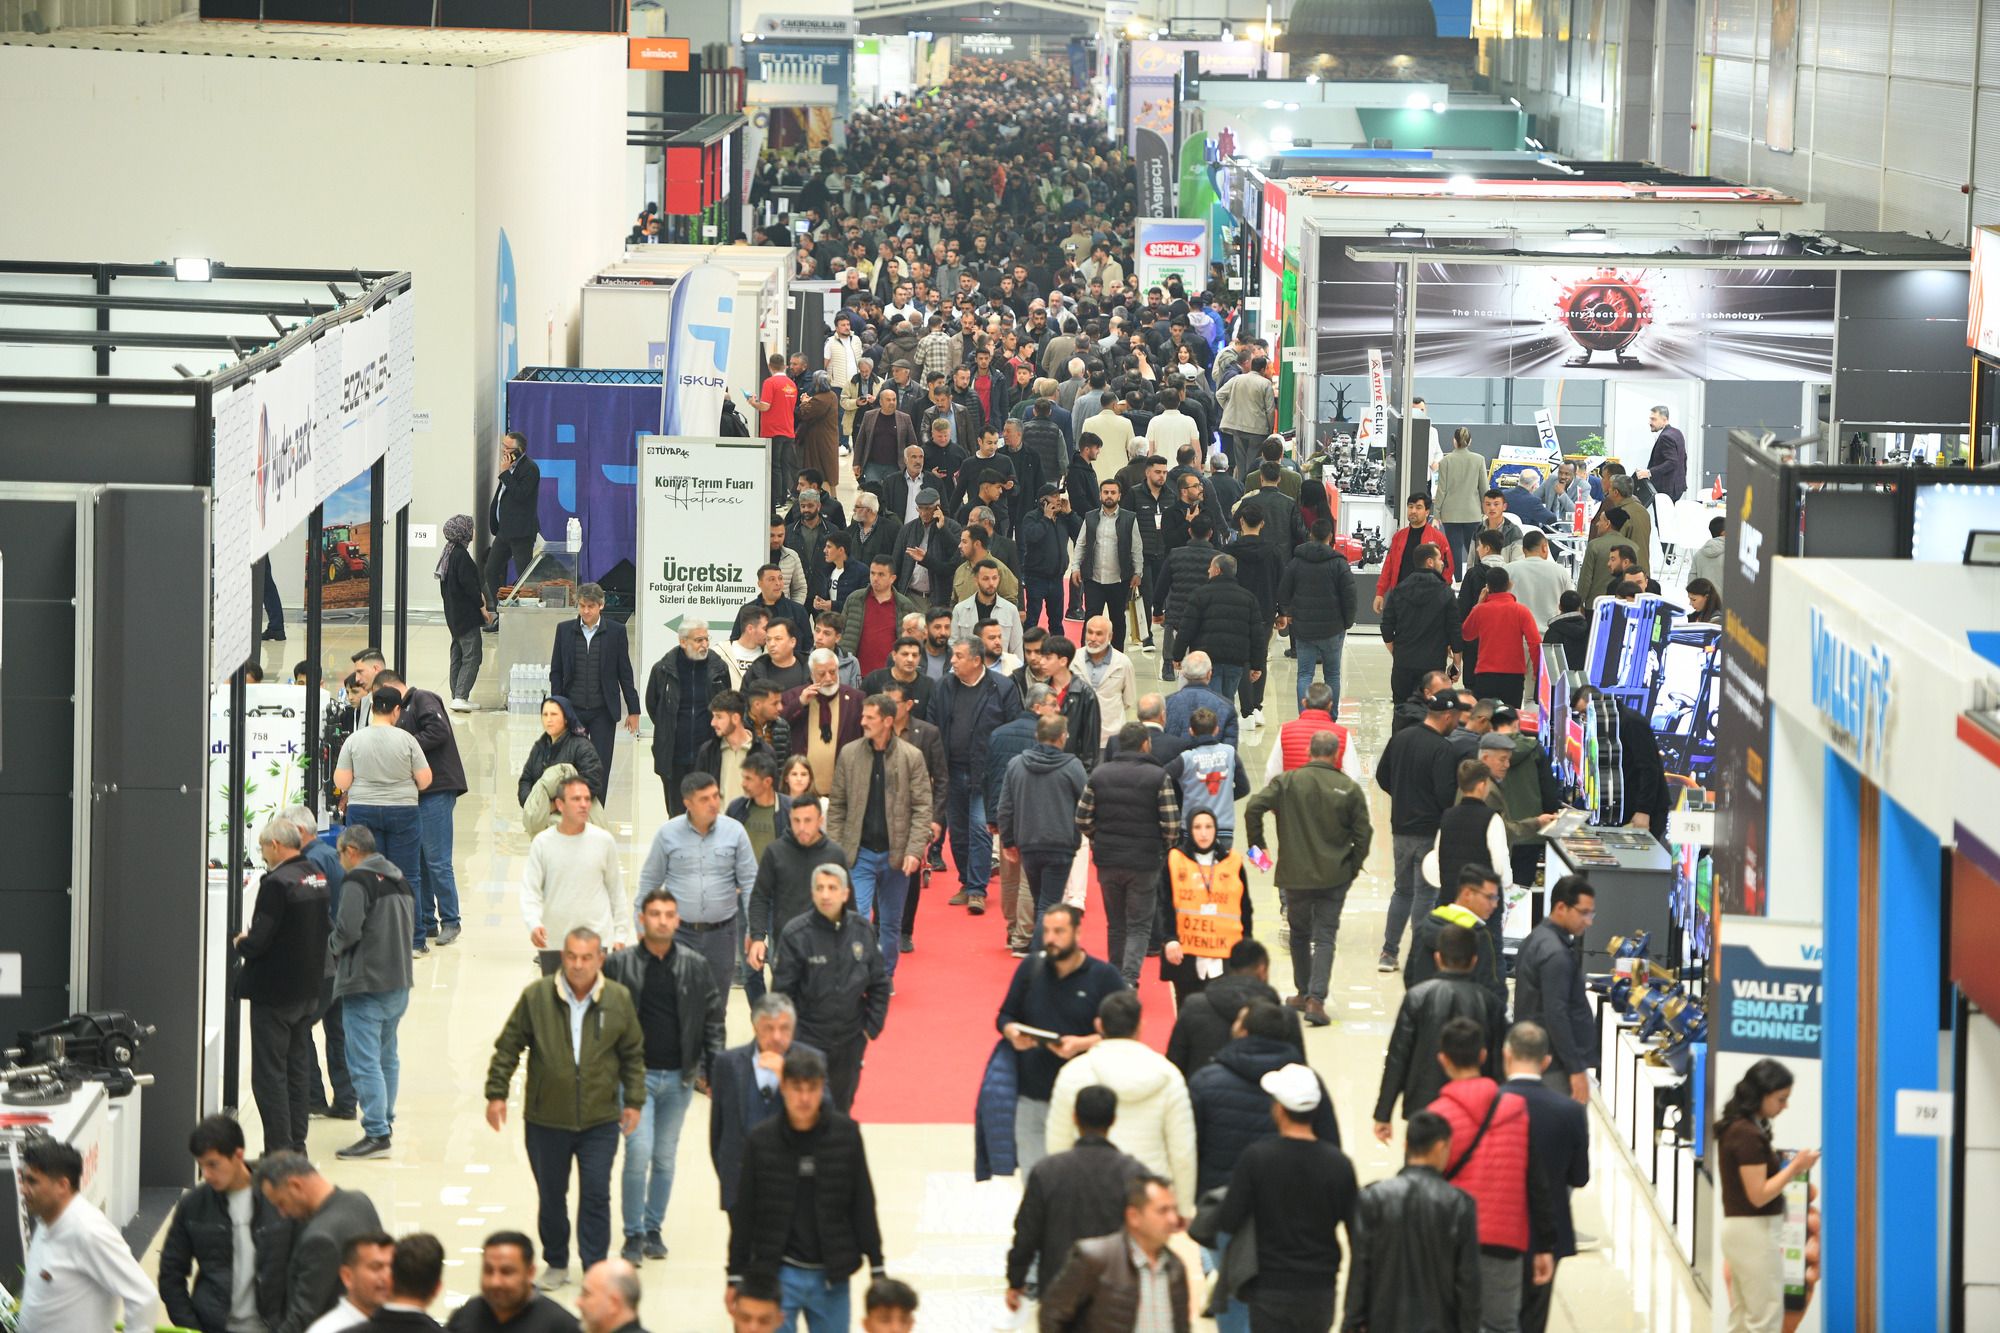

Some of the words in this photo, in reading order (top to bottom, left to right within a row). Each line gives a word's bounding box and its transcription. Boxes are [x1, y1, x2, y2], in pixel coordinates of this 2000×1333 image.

[758, 53, 840, 64] FUTURE
[1150, 158, 1165, 218] oyaltech
[1373, 372, 1384, 402] ATİYE
[655, 445, 680, 455] TÜYAP
[655, 476, 688, 490] Konya
[691, 476, 723, 489] Tarım
[725, 478, 754, 490] Fuarı
[414, 531, 427, 539] 759
[663, 556, 743, 583] Ücretsiz
[649, 582, 685, 593] Fotoğraf
[687, 583, 713, 594] Çekim
[715, 584, 756, 593] Alanımıza
[659, 595, 685, 604] Sizleri
[687, 596, 698, 605] de
[700, 596, 747, 606] Bekliyoruz!
[1810, 606, 1869, 764] VALLEY
[252, 732, 269, 741] 758
[1683, 822, 1701, 832] 751
[1183, 916, 1216, 933] ÖZEL
[1732, 979, 1814, 1003] VALLEY
[1731, 998, 1809, 1021] SMART
